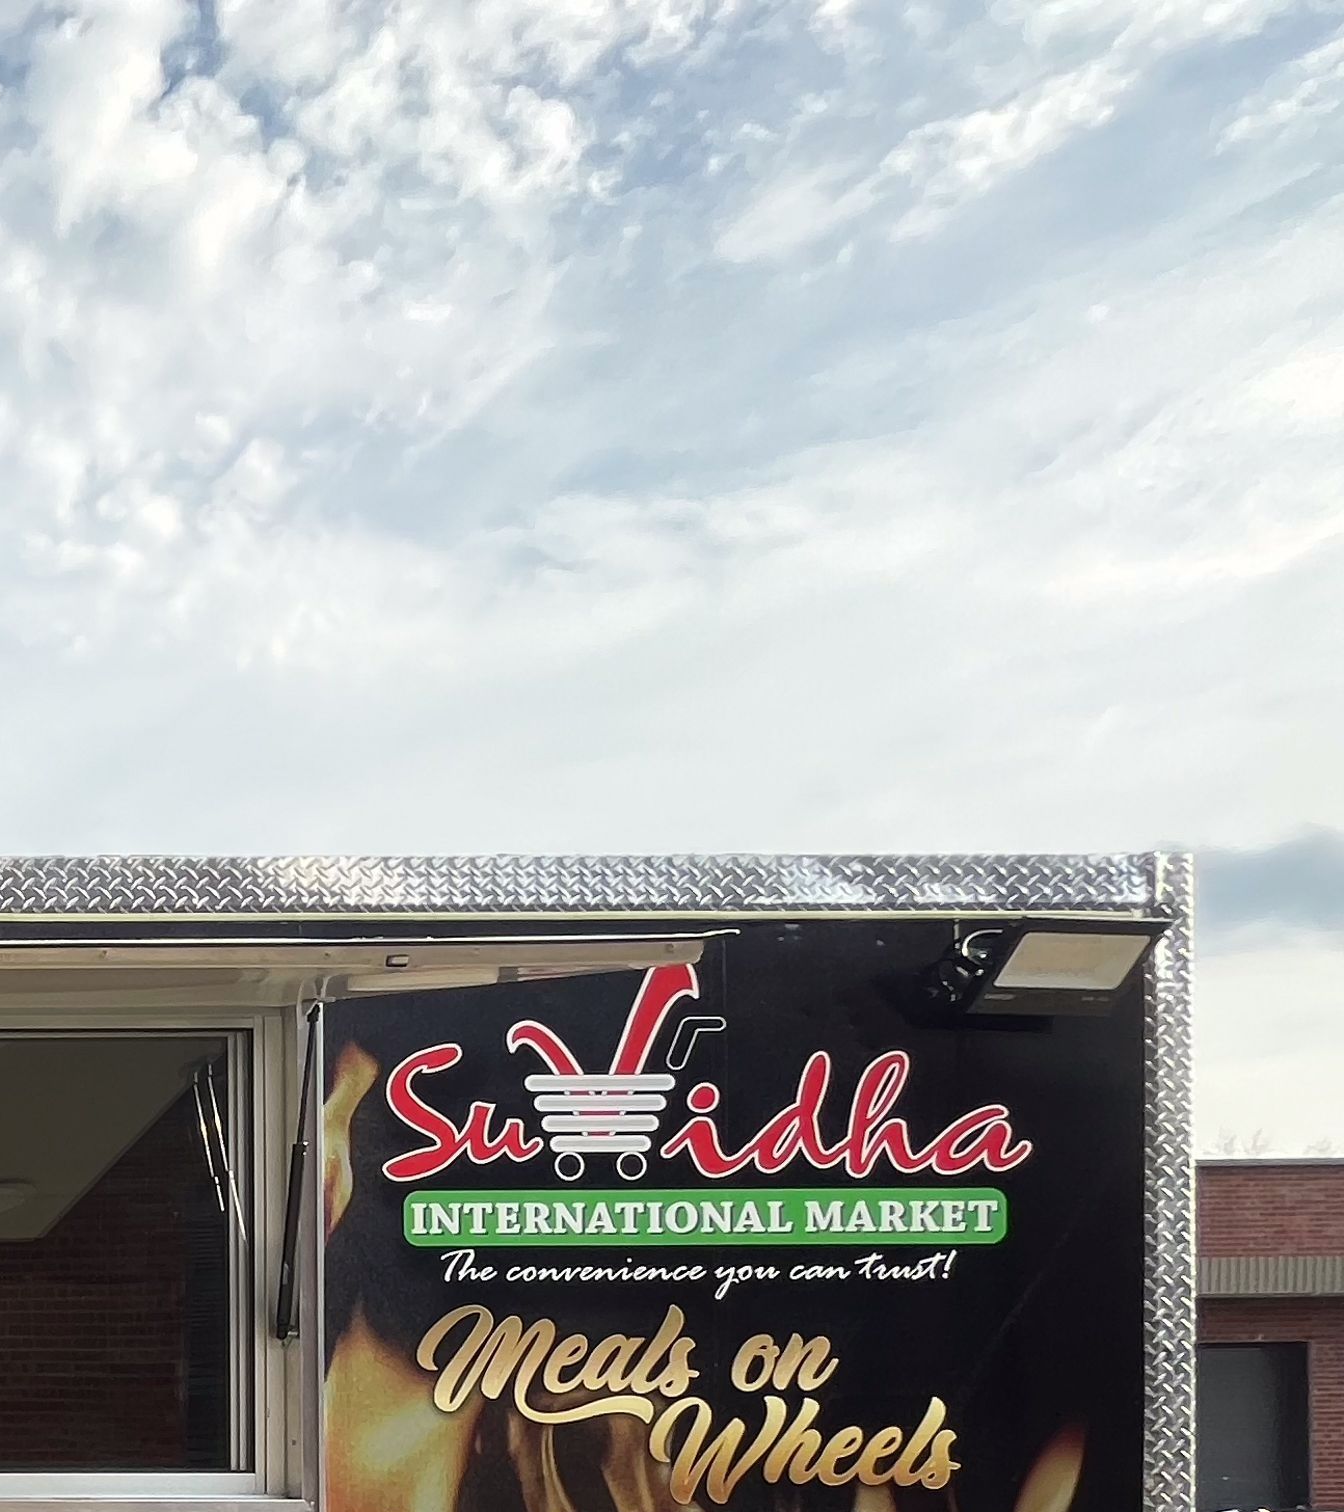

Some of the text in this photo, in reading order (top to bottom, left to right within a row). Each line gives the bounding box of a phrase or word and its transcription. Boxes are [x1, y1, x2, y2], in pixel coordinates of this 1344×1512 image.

[411, 1199, 999, 1236] INTERNATIONAL MARKET
[439, 1248, 957, 1300] The convenience you can trust!
[416, 1303, 839, 1424] Meals on
[649, 1396, 962, 1505] Wheels
